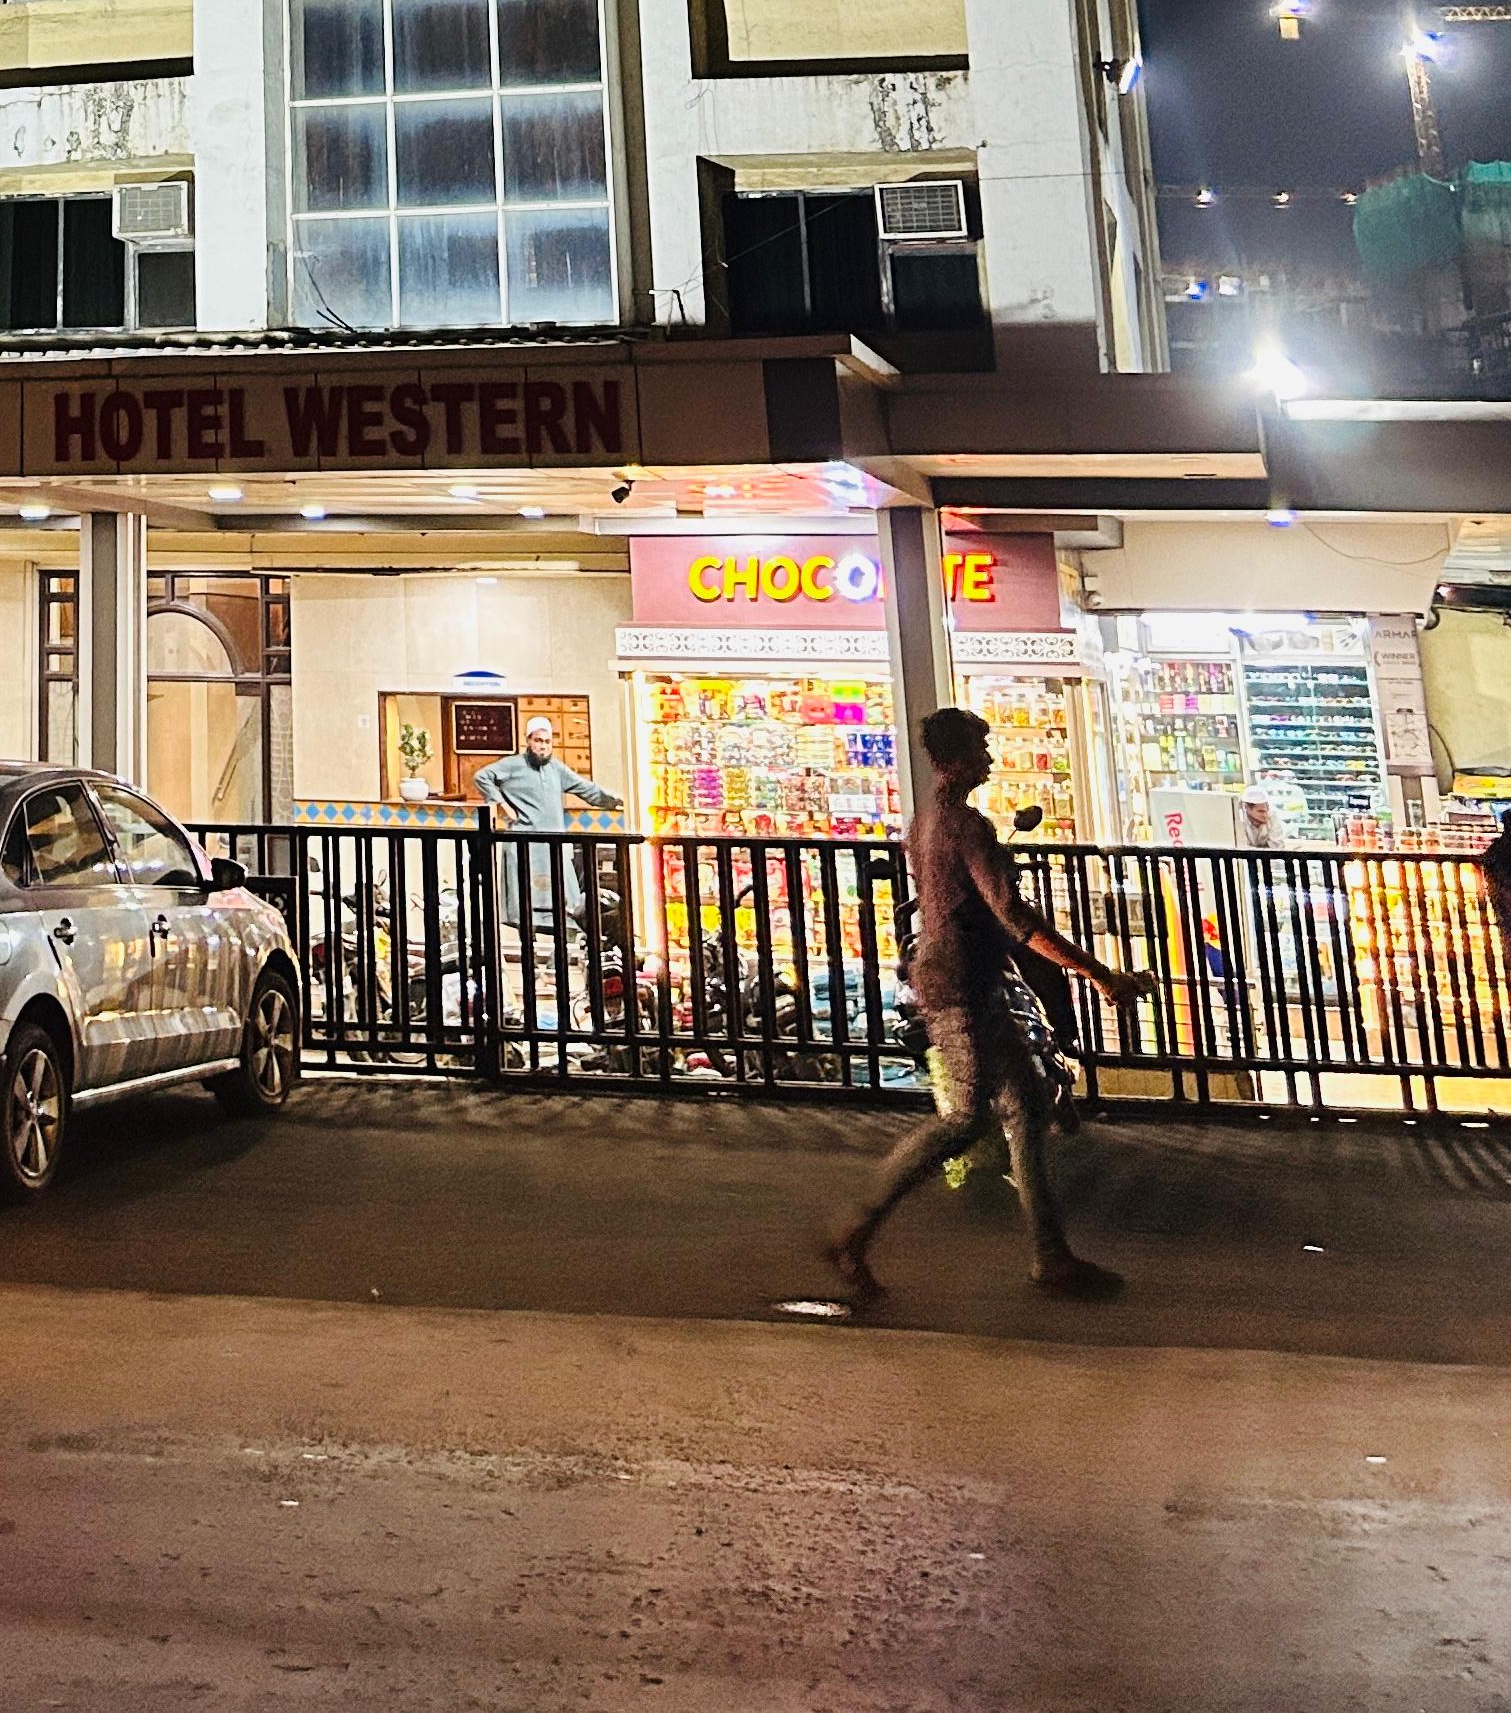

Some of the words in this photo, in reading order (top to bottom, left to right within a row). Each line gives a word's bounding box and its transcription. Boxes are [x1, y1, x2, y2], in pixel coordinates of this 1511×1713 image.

[54, 388, 265, 463] HOTEL
[284, 380, 622, 458] WESTERN
[688, 551, 999, 602] CHOCOTE
